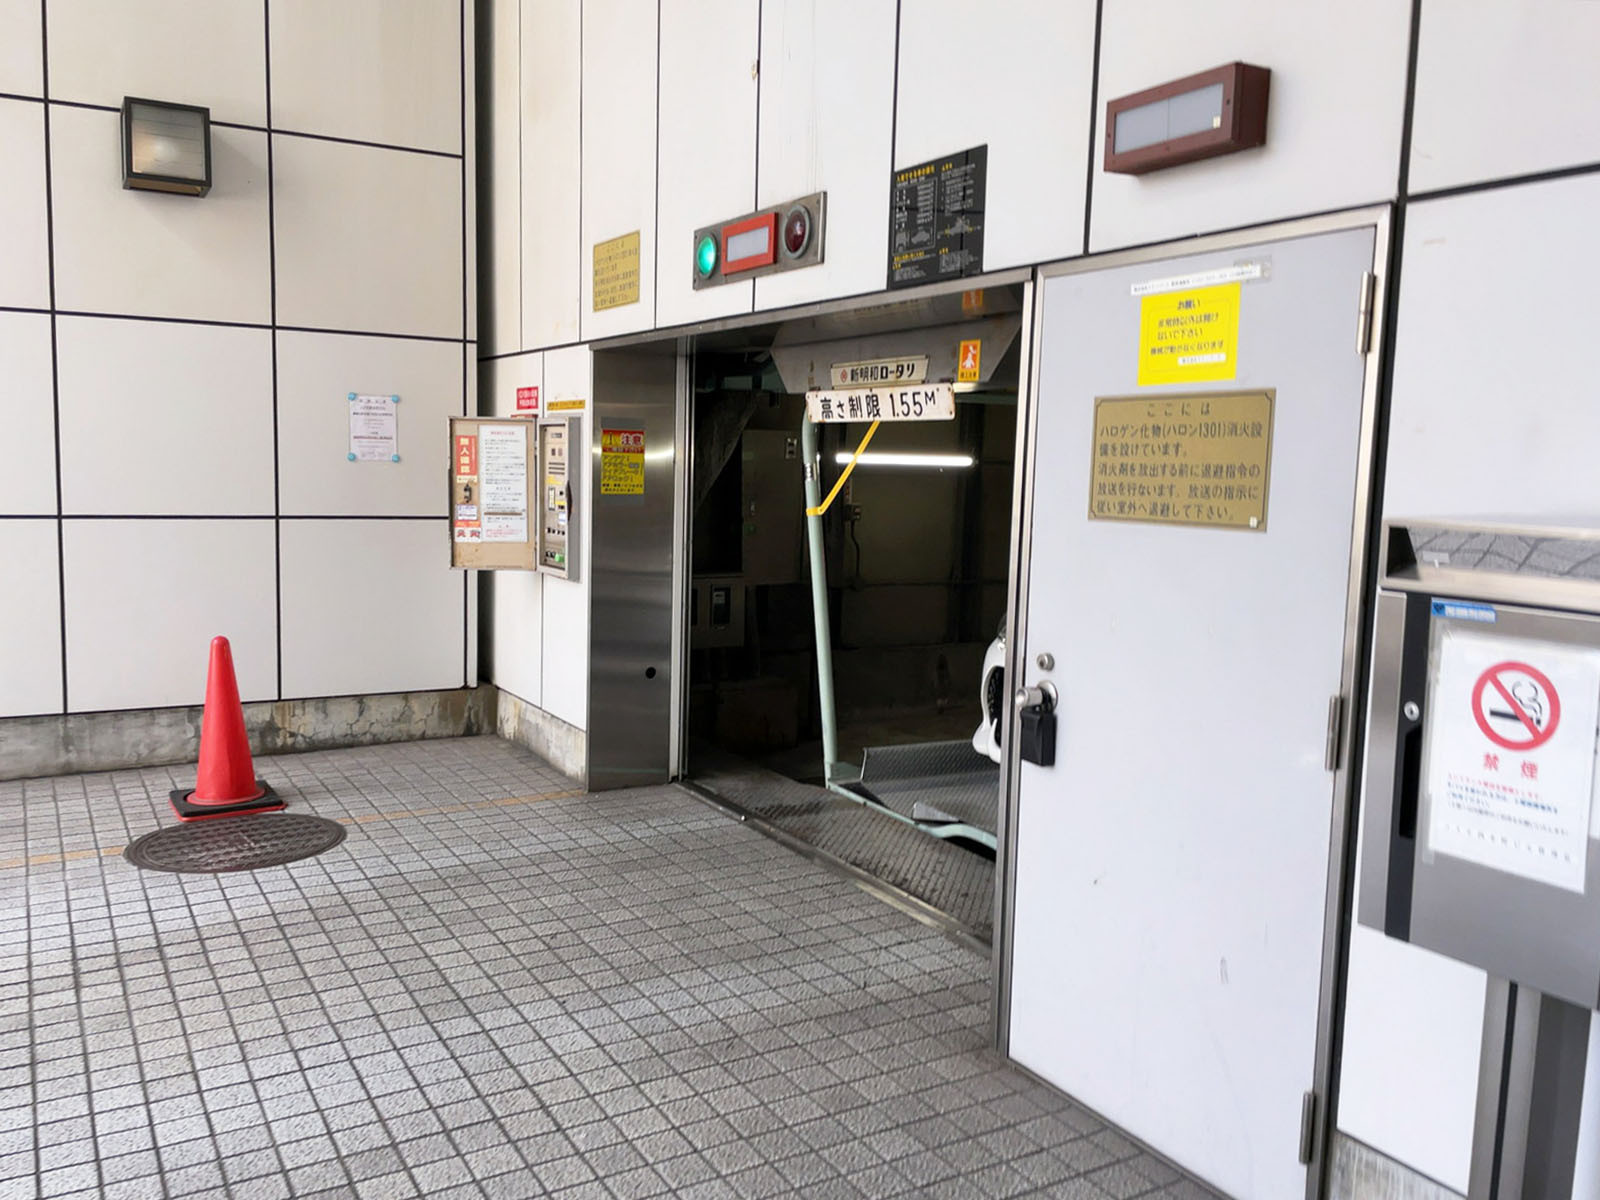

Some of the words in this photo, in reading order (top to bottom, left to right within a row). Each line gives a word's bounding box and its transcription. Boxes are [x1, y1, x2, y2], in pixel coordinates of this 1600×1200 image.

[1177, 298, 1201, 310] お願い
[1157, 328, 1204, 341] ないで下さい
[850, 363, 915, 383] 新明和ロータリ
[820, 394, 881, 420] 高さ制限
[1098, 462, 1261, 480] 消火剤を放出する前に退避指令の
